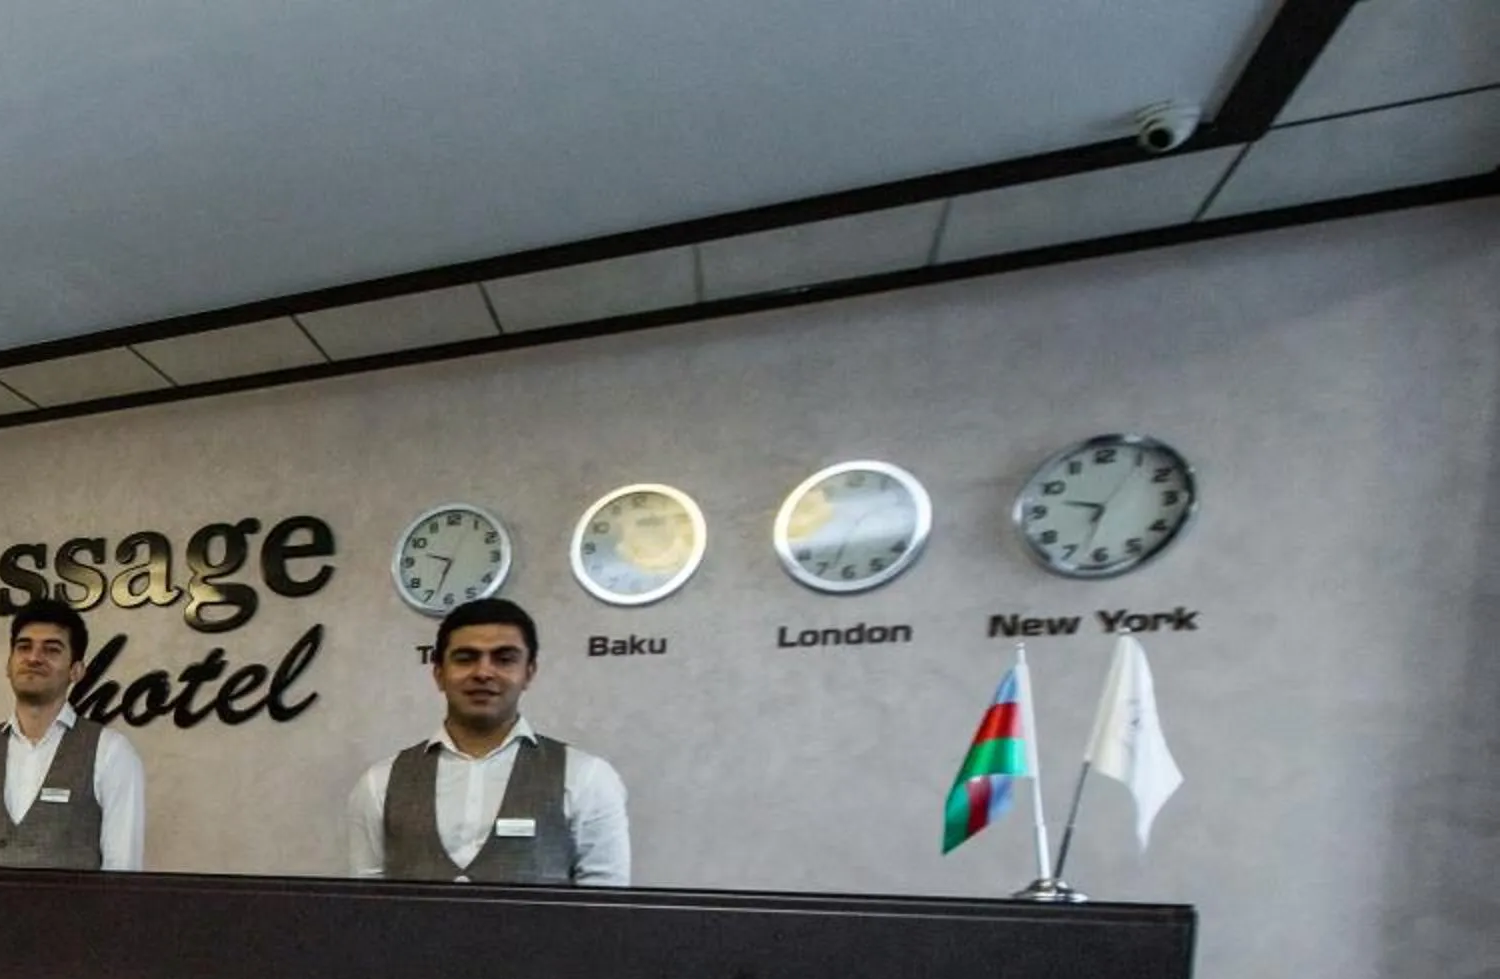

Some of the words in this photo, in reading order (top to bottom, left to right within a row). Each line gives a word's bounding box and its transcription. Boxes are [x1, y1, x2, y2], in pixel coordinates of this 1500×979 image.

[1042, 480, 1066, 495] 10
[411, 537, 427, 549] 10
[1061, 544, 1079, 560] 7
[1092, 547, 1109, 562] 6
[423, 589, 435, 603] 7
[988, 613, 1082, 638] New
[1096, 606, 1200, 634] York
[777, 622, 914, 648] London
[588, 634, 667, 657] Baku
[68, 624, 323, 728] hotel
